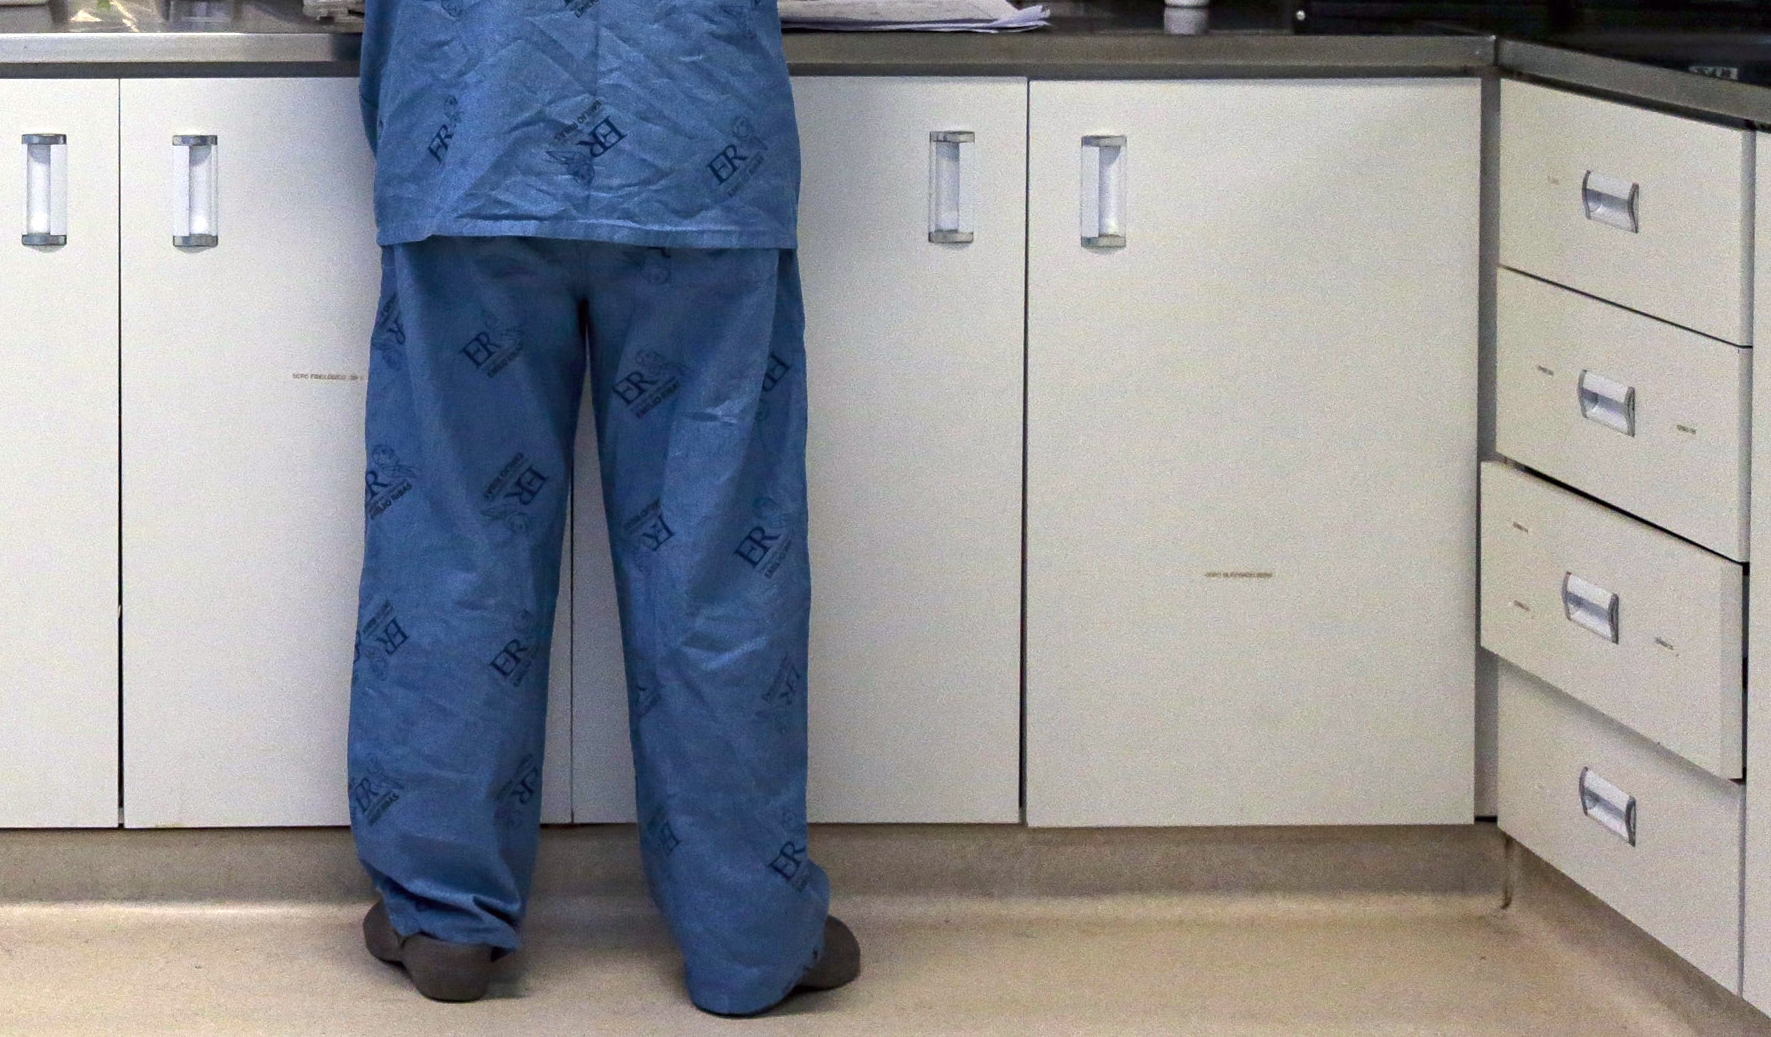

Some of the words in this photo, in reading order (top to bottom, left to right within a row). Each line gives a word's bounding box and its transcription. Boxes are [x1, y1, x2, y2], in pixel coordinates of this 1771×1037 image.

[575, 115, 628, 158] ER
[705, 144, 748, 186] ER
[458, 331, 503, 368] ER
[612, 371, 660, 405] ER
[503, 466, 549, 506] ER
[733, 525, 781, 569] ER
[375, 617, 410, 656] ER
[489, 638, 529, 678] ER
[768, 840, 807, 881] ER
